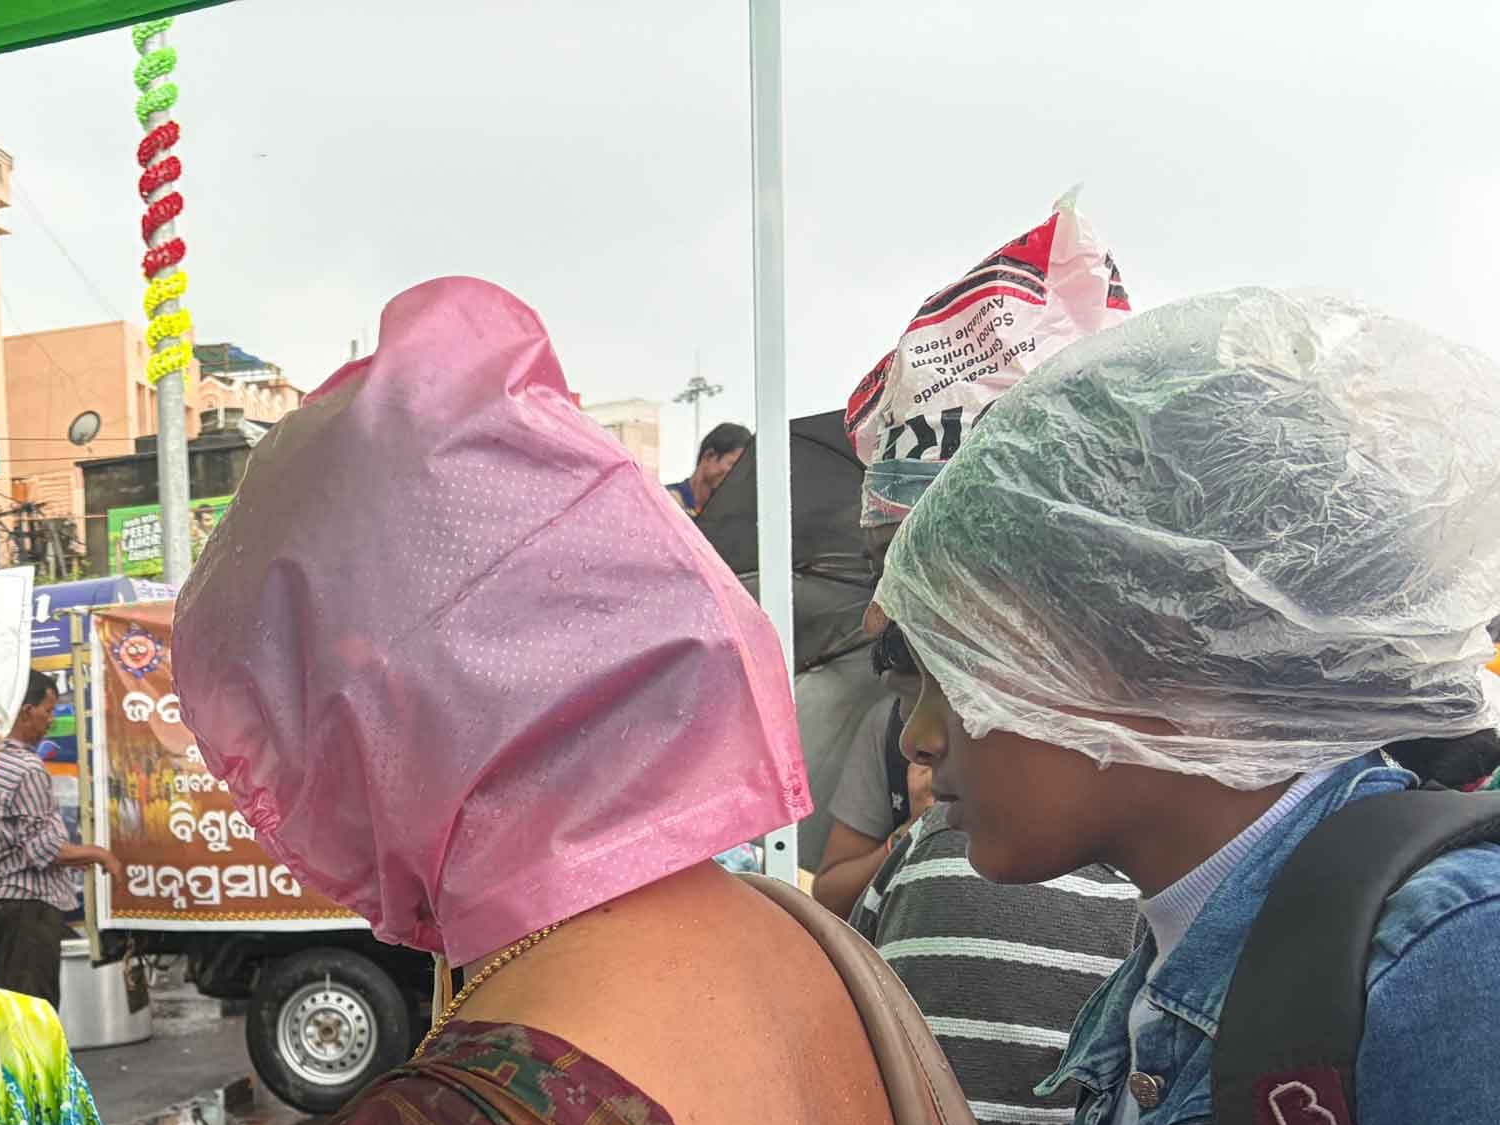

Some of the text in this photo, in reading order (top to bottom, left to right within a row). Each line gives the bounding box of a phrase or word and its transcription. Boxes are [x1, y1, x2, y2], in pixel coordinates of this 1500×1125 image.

[909, 295, 1005, 355] Available Here.
[911, 312, 1014, 369] School Uniform
